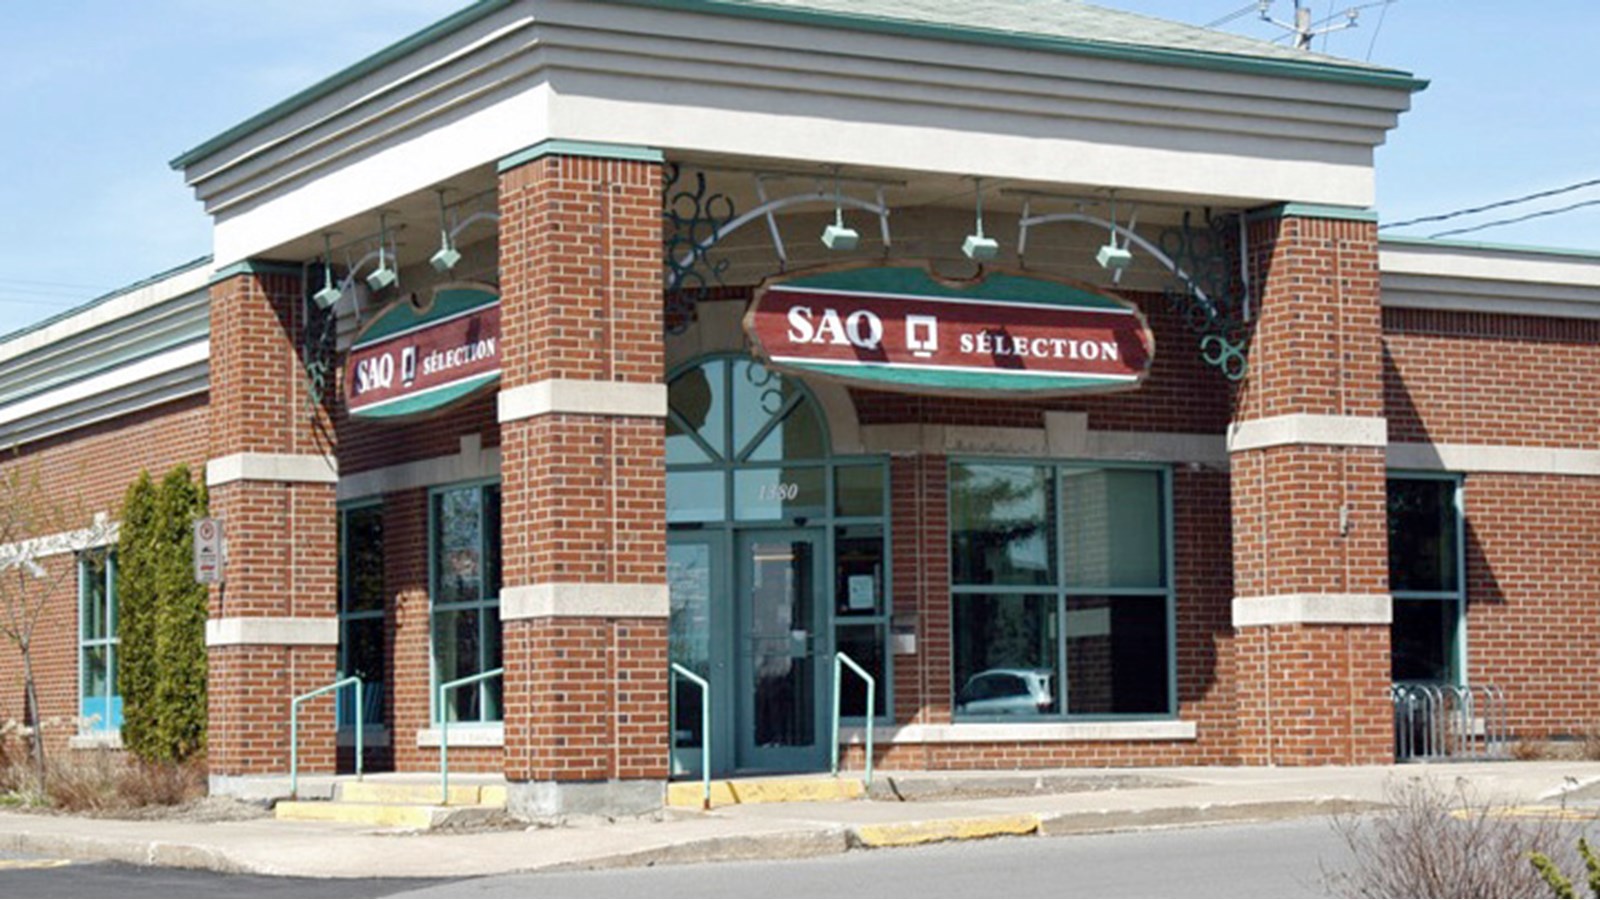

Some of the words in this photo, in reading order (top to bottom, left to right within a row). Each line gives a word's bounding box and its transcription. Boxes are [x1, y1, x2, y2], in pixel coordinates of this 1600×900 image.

[787, 305, 883, 350] SAQ
[960, 330, 1118, 361] SÉLECTION
[357, 352, 394, 394] SAQ
[423, 337, 496, 375] SÉLECTION
[758, 483, 798, 500] 1380
